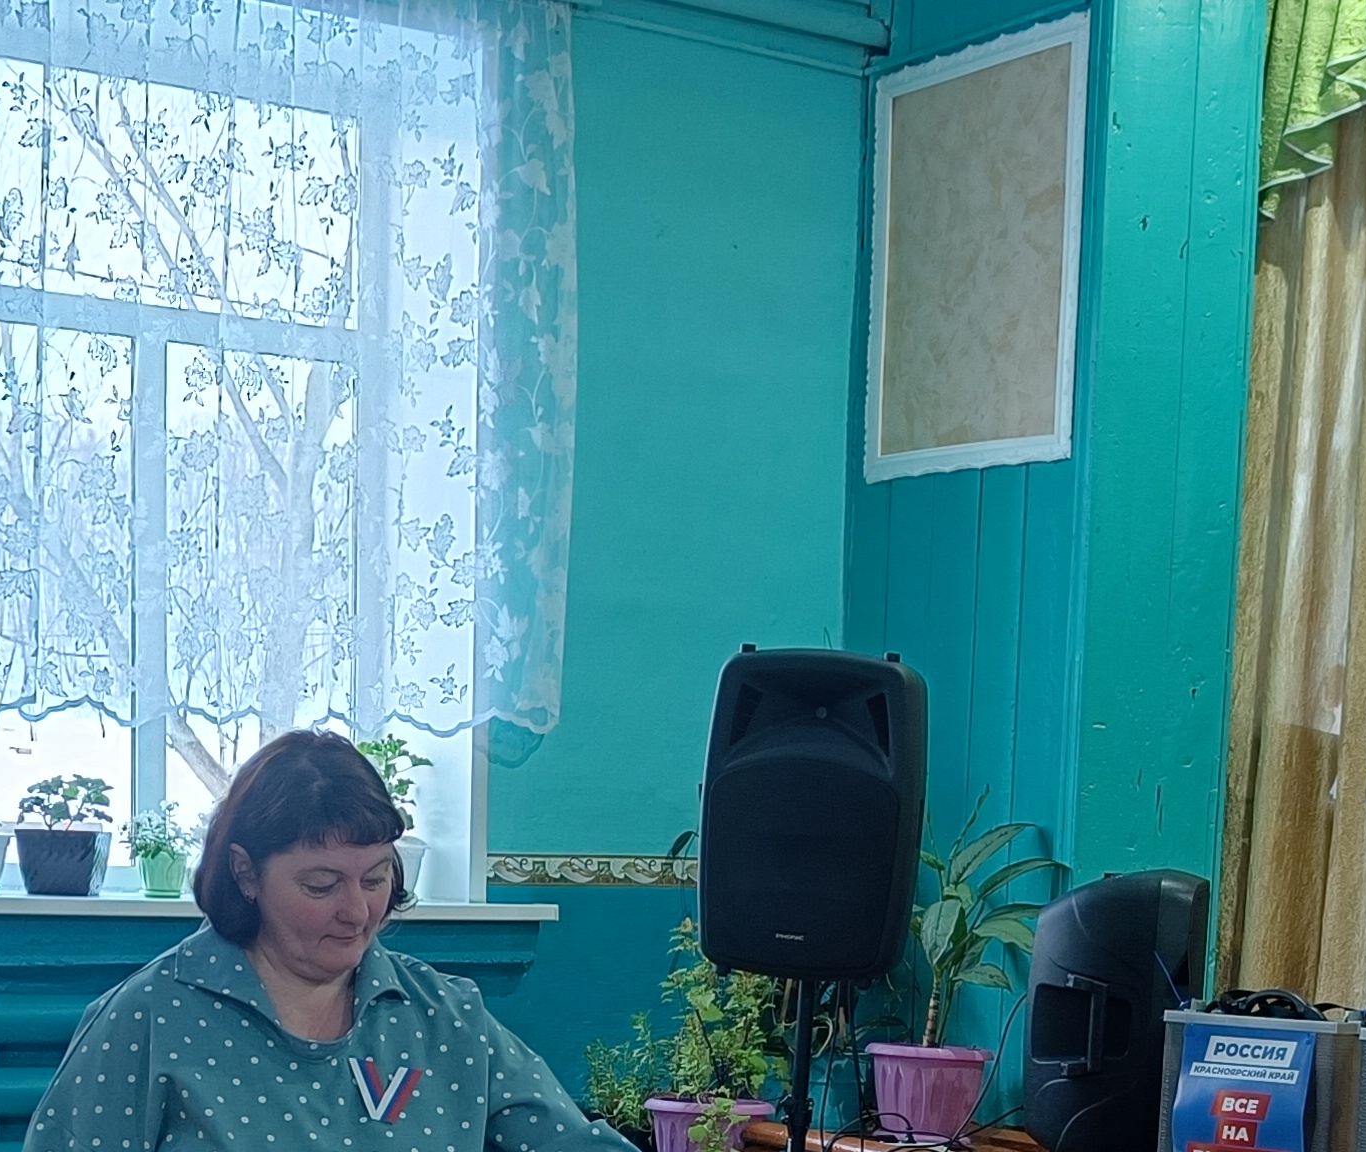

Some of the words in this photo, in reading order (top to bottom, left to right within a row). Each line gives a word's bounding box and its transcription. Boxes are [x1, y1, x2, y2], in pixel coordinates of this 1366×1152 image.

[1213, 1041, 1288, 1061] РОССИЯ
[1193, 1065, 1267, 1079] КРАСНОЯРСКИЙ
[1267, 1070, 1296, 1081] КРАЙ
[1221, 1096, 1260, 1115] ВСЕ
[1221, 1125, 1250, 1142] НА
